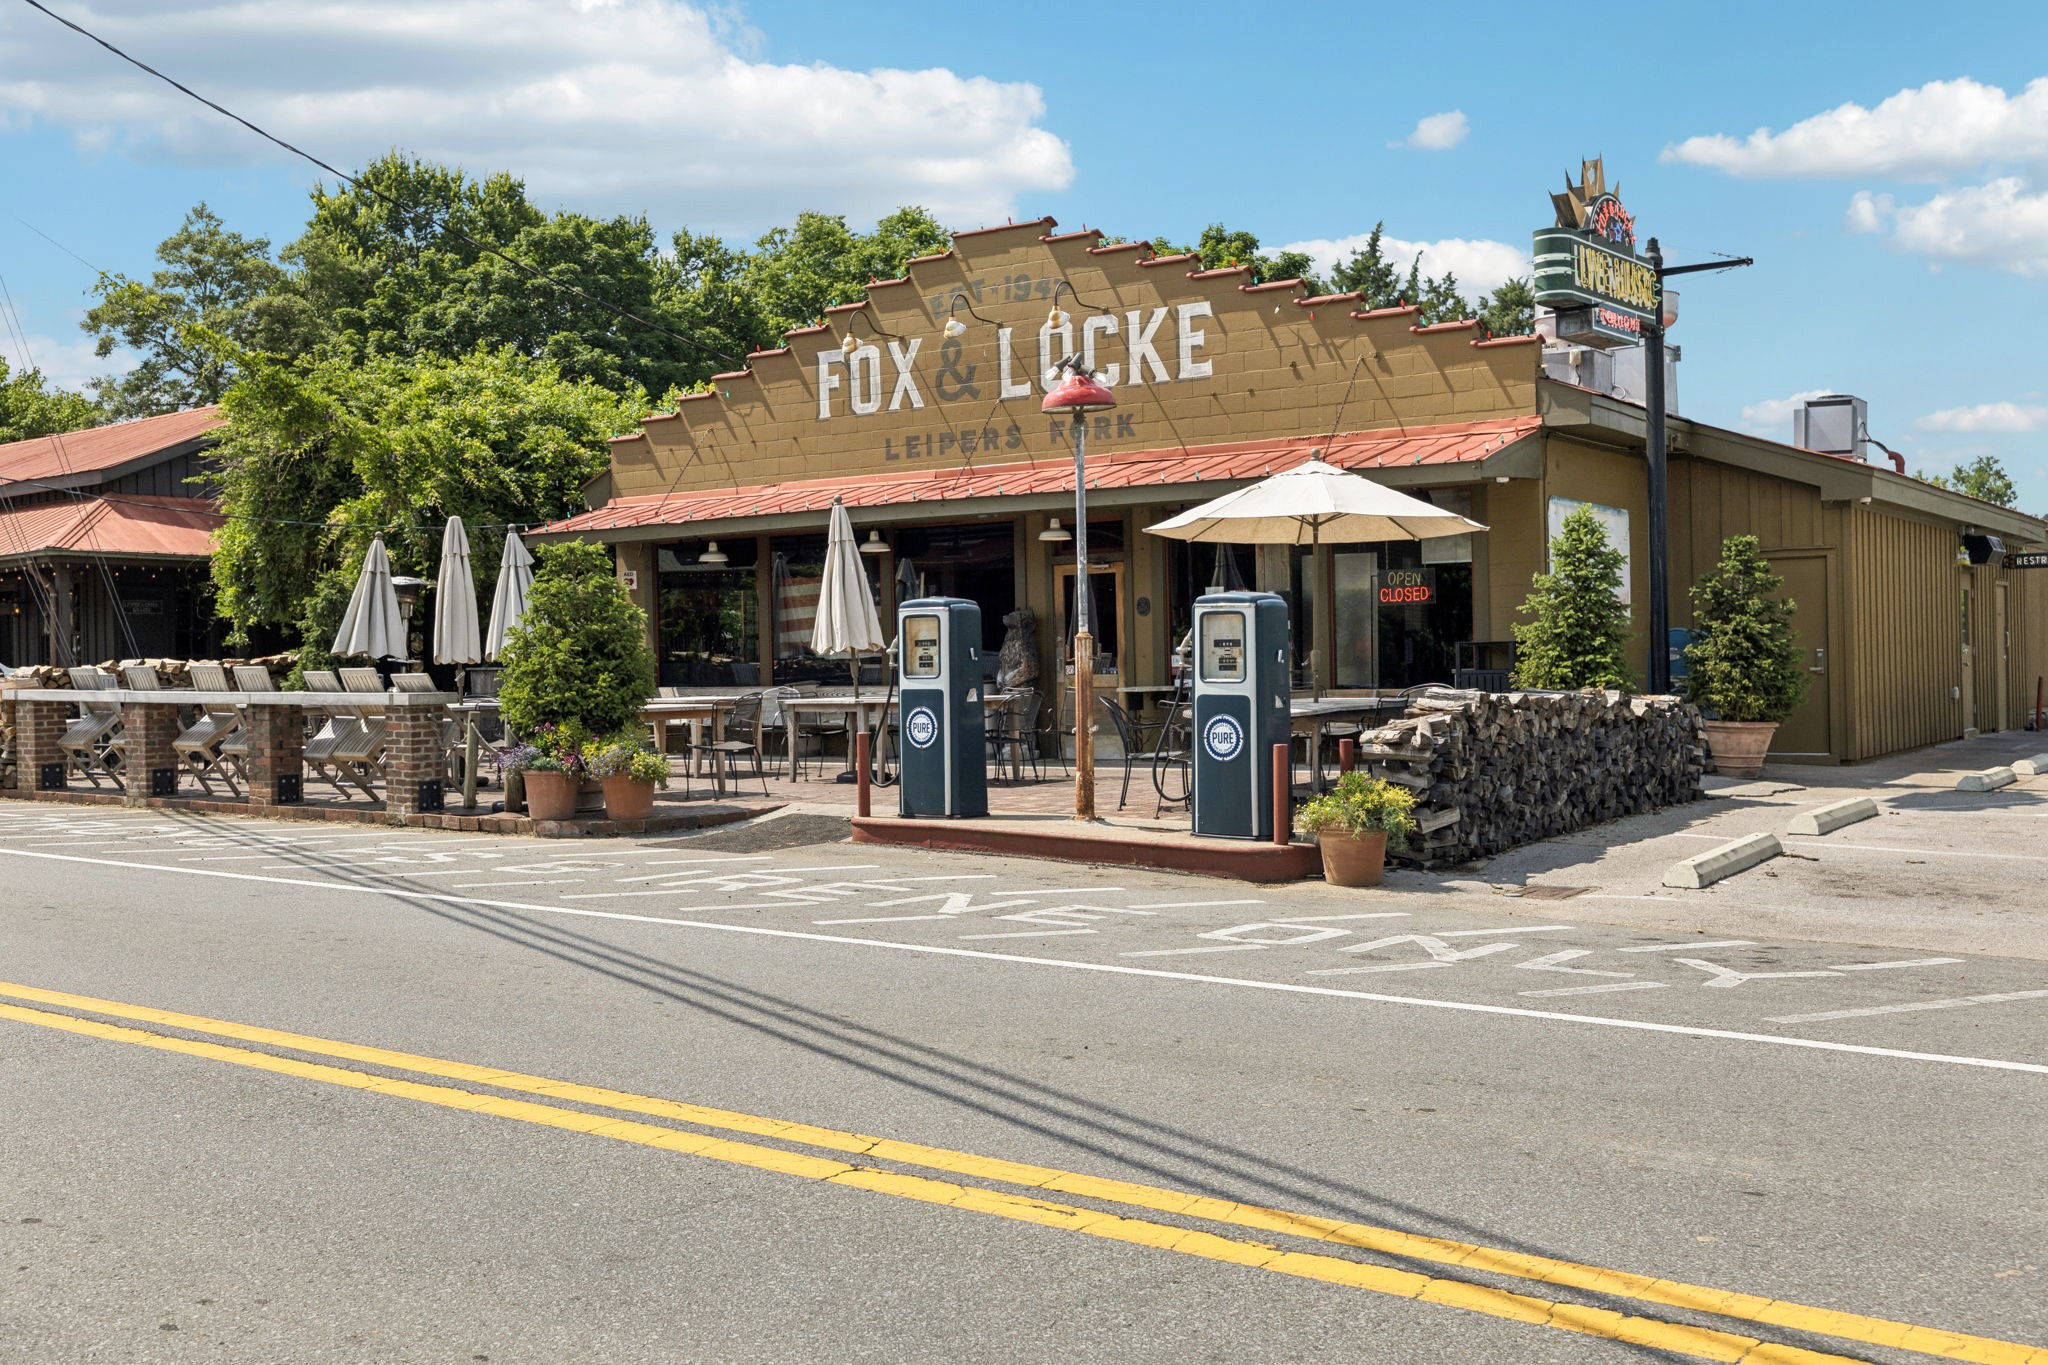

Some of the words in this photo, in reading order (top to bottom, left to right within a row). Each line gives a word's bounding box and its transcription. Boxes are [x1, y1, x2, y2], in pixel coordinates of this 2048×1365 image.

[816, 338, 925, 421] FOX
[935, 338, 981, 403] &
[998, 300, 1214, 402] LOCKE
[884, 424, 1022, 461] LEIPERS
[1049, 412, 1136, 445] FORK
[1387, 571, 1421, 586] OPEN
[1380, 586, 1430, 604] CLOSED
[912, 722, 931, 734] PURE
[1212, 731, 1234, 744] PURE
[1197, 921, 1846, 989] ONLY
